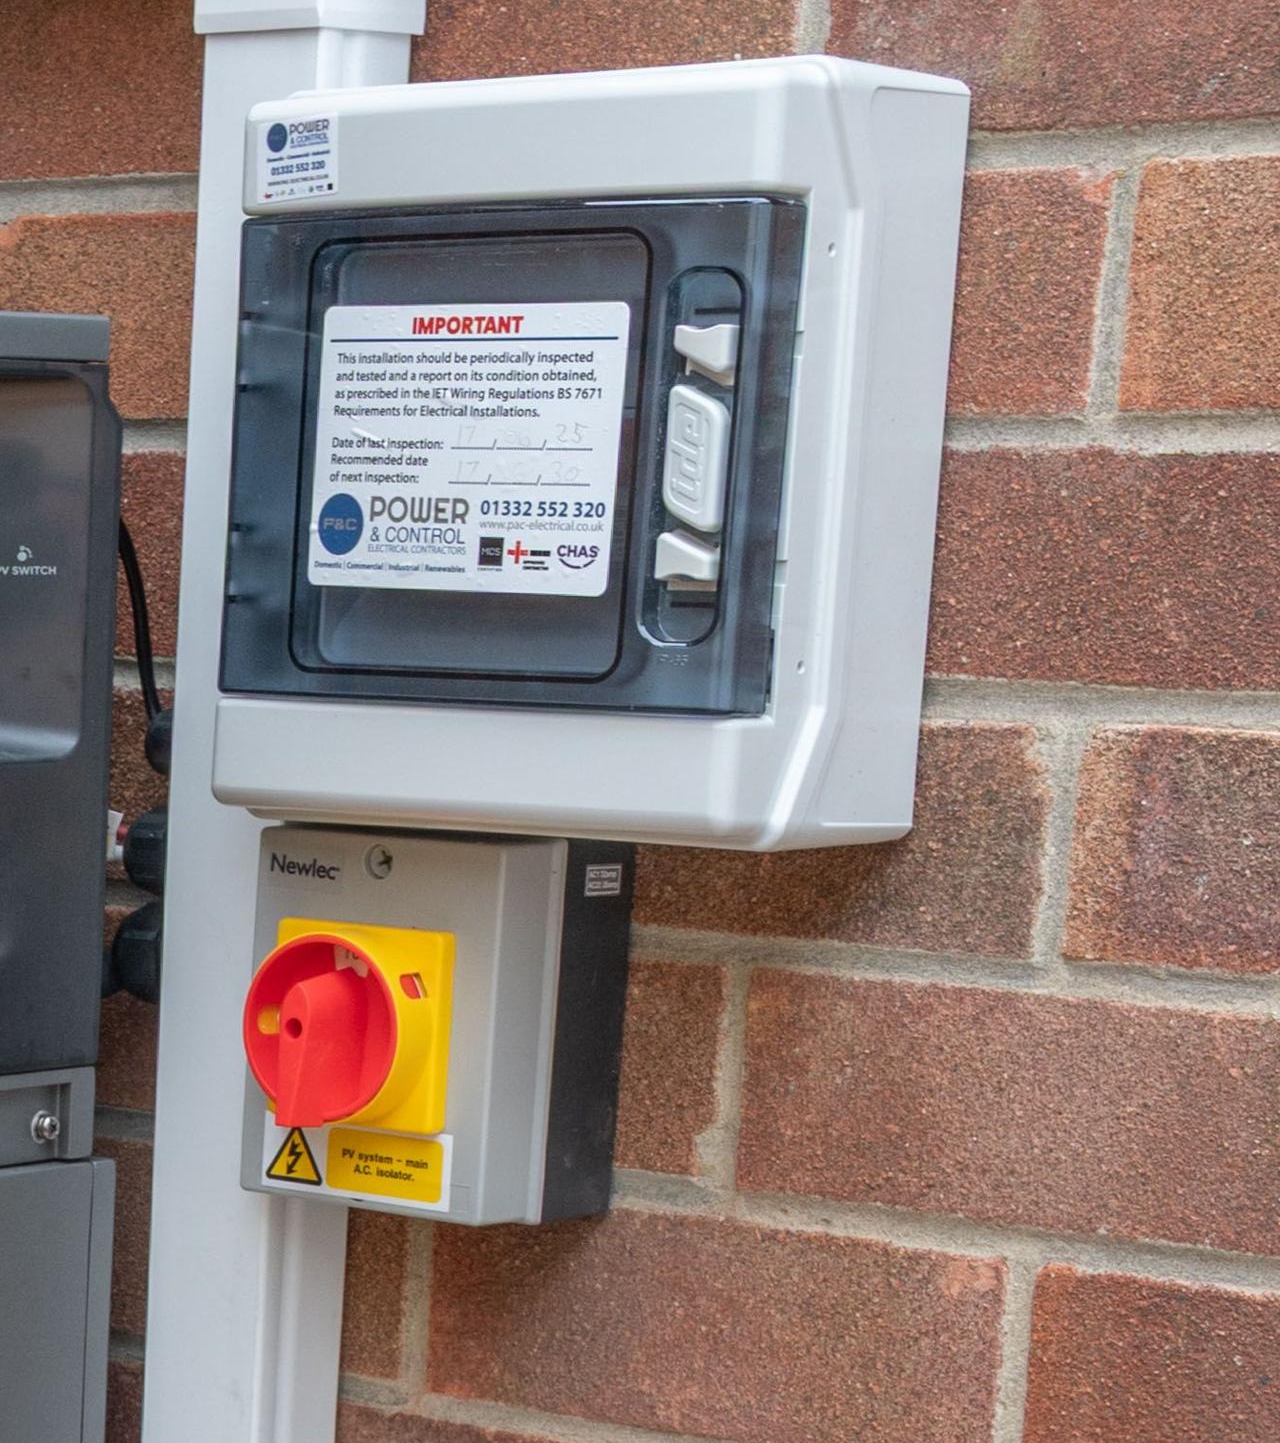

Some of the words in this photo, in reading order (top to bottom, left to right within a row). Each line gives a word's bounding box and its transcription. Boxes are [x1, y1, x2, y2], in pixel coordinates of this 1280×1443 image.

[289, 119, 329, 135] POWER
[271, 164, 294, 176] 01332
[295, 162, 309, 173] 552
[311, 160, 325, 171] 320
[412, 316, 524, 334] IMPORTANT
[338, 353, 356, 364] This
[358, 352, 414, 364] installation
[416, 352, 451, 364] should
[454, 352, 467, 364] be
[470, 351, 534, 366] periodically
[537, 351, 593, 366] inspected
[336, 371, 354, 382] and
[356, 371, 386, 382] tested
[388, 371, 408, 382] and
[410, 373, 417, 382] a
[418, 371, 452, 384] report
[455, 372, 468, 381] on
[471, 370, 484, 381] its
[486, 370, 539, 382] condition
[542, 370, 597, 383] obtained,
[335, 391, 345, 400] as
[347, 388, 398, 402] prescribed
[400, 389, 409, 399] in
[413, 388, 430, 400] the
[432, 388, 448, 400] IET
[450, 388, 485, 402] Wiring
[488, 388, 554, 402] Regulations
[557, 388, 571, 399] BS
[574, 388, 602, 399] 7671
[334, 406, 400, 418] Requirements
[403, 406, 417, 417] for
[421, 406, 467, 417] Electrical
[470, 406, 540, 418] Installations.
[332, 438, 354, 450] Date
[356, 438, 366, 449] of
[367, 438, 385, 449] last
[388, 438, 443, 452] inspection:
[331, 455, 404, 466] Recommended
[407, 456, 428, 466] date
[329, 472, 340, 483] of
[341, 472, 363, 484] next
[365, 472, 419, 487] inspection:
[369, 496, 470, 524] POWER
[480, 500, 532, 517] 01332
[537, 501, 572, 517] 552
[574, 502, 606, 518] 320
[323, 518, 357, 530] P&C
[479, 519, 604, 532] www.pac-electrical.co.uk
[370, 527, 380, 542] &
[385, 526, 465, 544] CONTROL
[368, 544, 408, 553] ELECTRICAL
[411, 545, 466, 555] CONTRACTORS
[481, 547, 501, 556] MCS
[557, 544, 598, 558] CHAS
[11, 565, 57, 575] SWITCH
[314, 561, 342, 569] Domestic
[346, 562, 383, 570] Commercial
[388, 563, 419, 571] Industrial
[425, 565, 465, 573] Renewables
[270, 852, 340, 881] Newlec
[342, 1148, 355, 1159] PV
[358, 1152, 393, 1164] system
[405, 1159, 428, 1169] main
[354, 1164, 372, 1175] A.C.
[376, 1167, 415, 1181] isolator.
